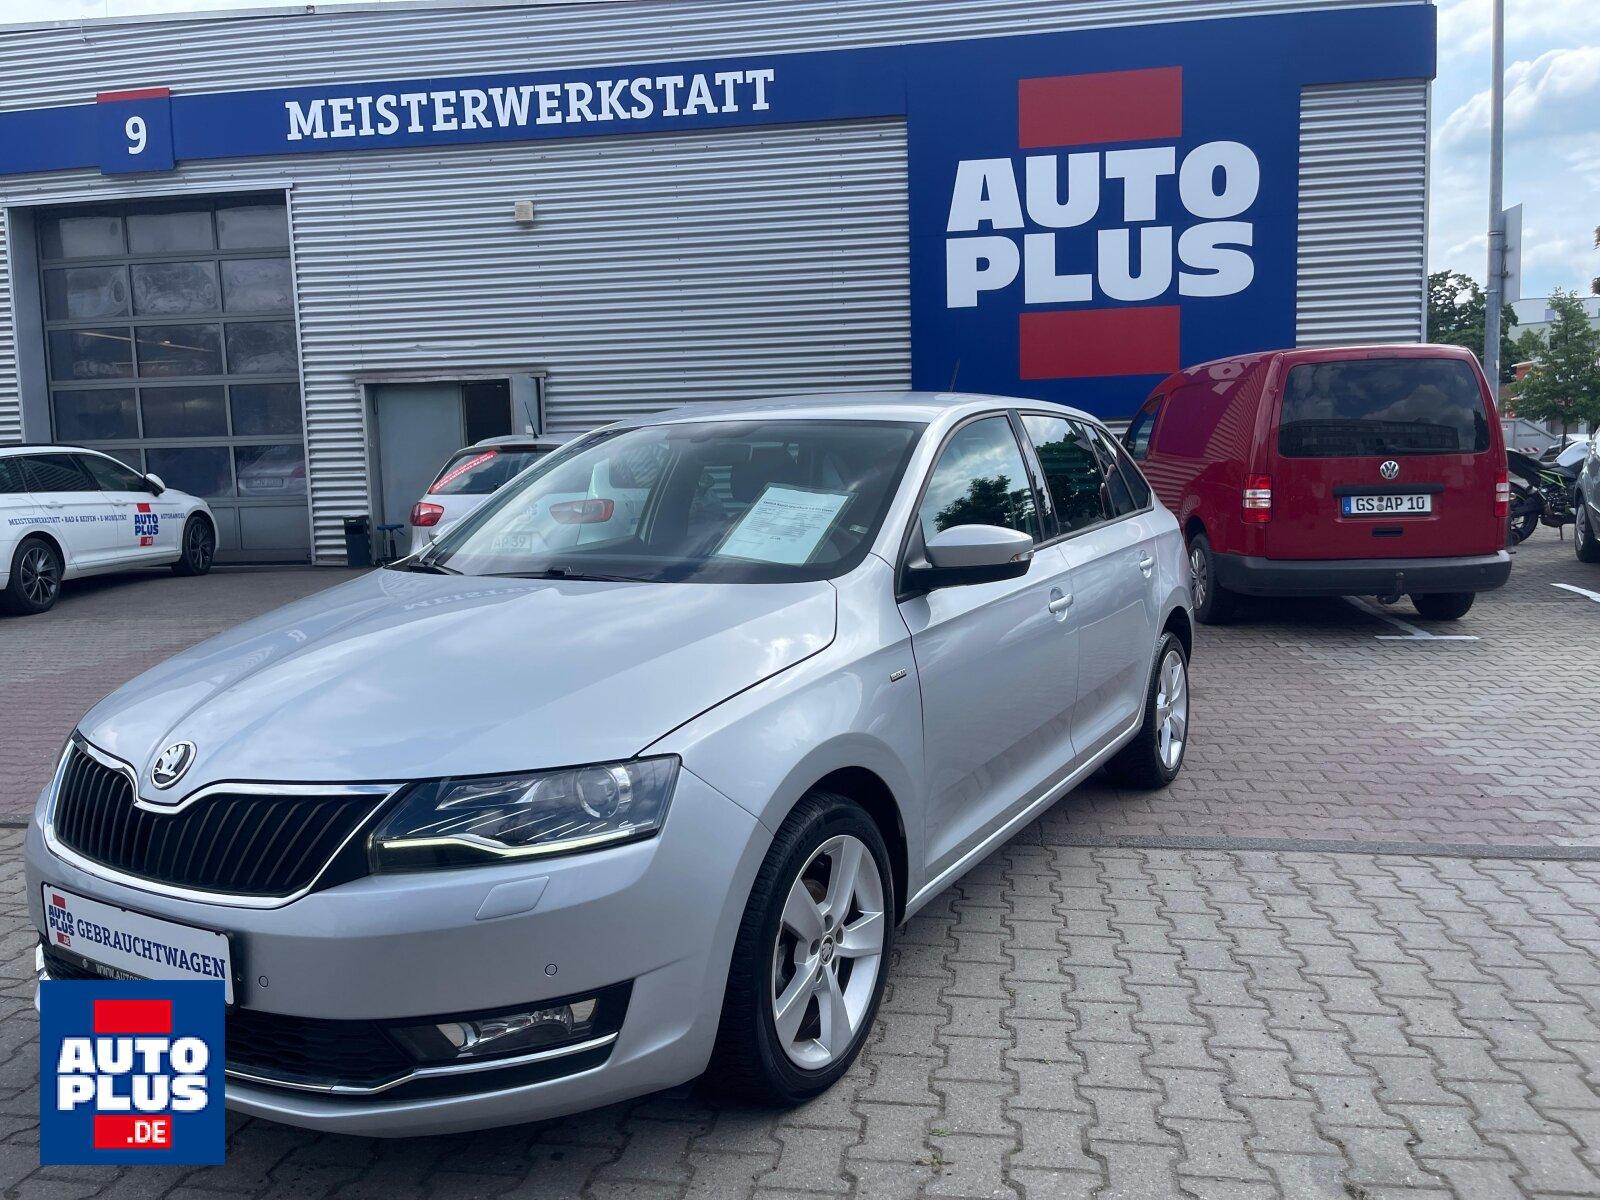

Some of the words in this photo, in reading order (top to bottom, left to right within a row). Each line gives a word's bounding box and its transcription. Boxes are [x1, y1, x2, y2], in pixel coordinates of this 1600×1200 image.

[285, 69, 776, 141] MEISTERWERKSTATT
[126, 116, 147, 155] 9
[946, 140, 1260, 232] AUTO
[946, 220, 1255, 308] PLUS
[1356, 497, 1375, 512] GS
[1385, 497, 1403, 511] AP
[1407, 496, 1425, 511] 10
[134, 513, 159, 525] AUTO
[134, 524, 159, 536] PLUS
[511, 535, 526, 548] 39
[48, 904, 73, 924] AUTO
[49, 916, 75, 937] PLUS
[77, 918, 226, 979] GEBRAUCHTWAGEN
